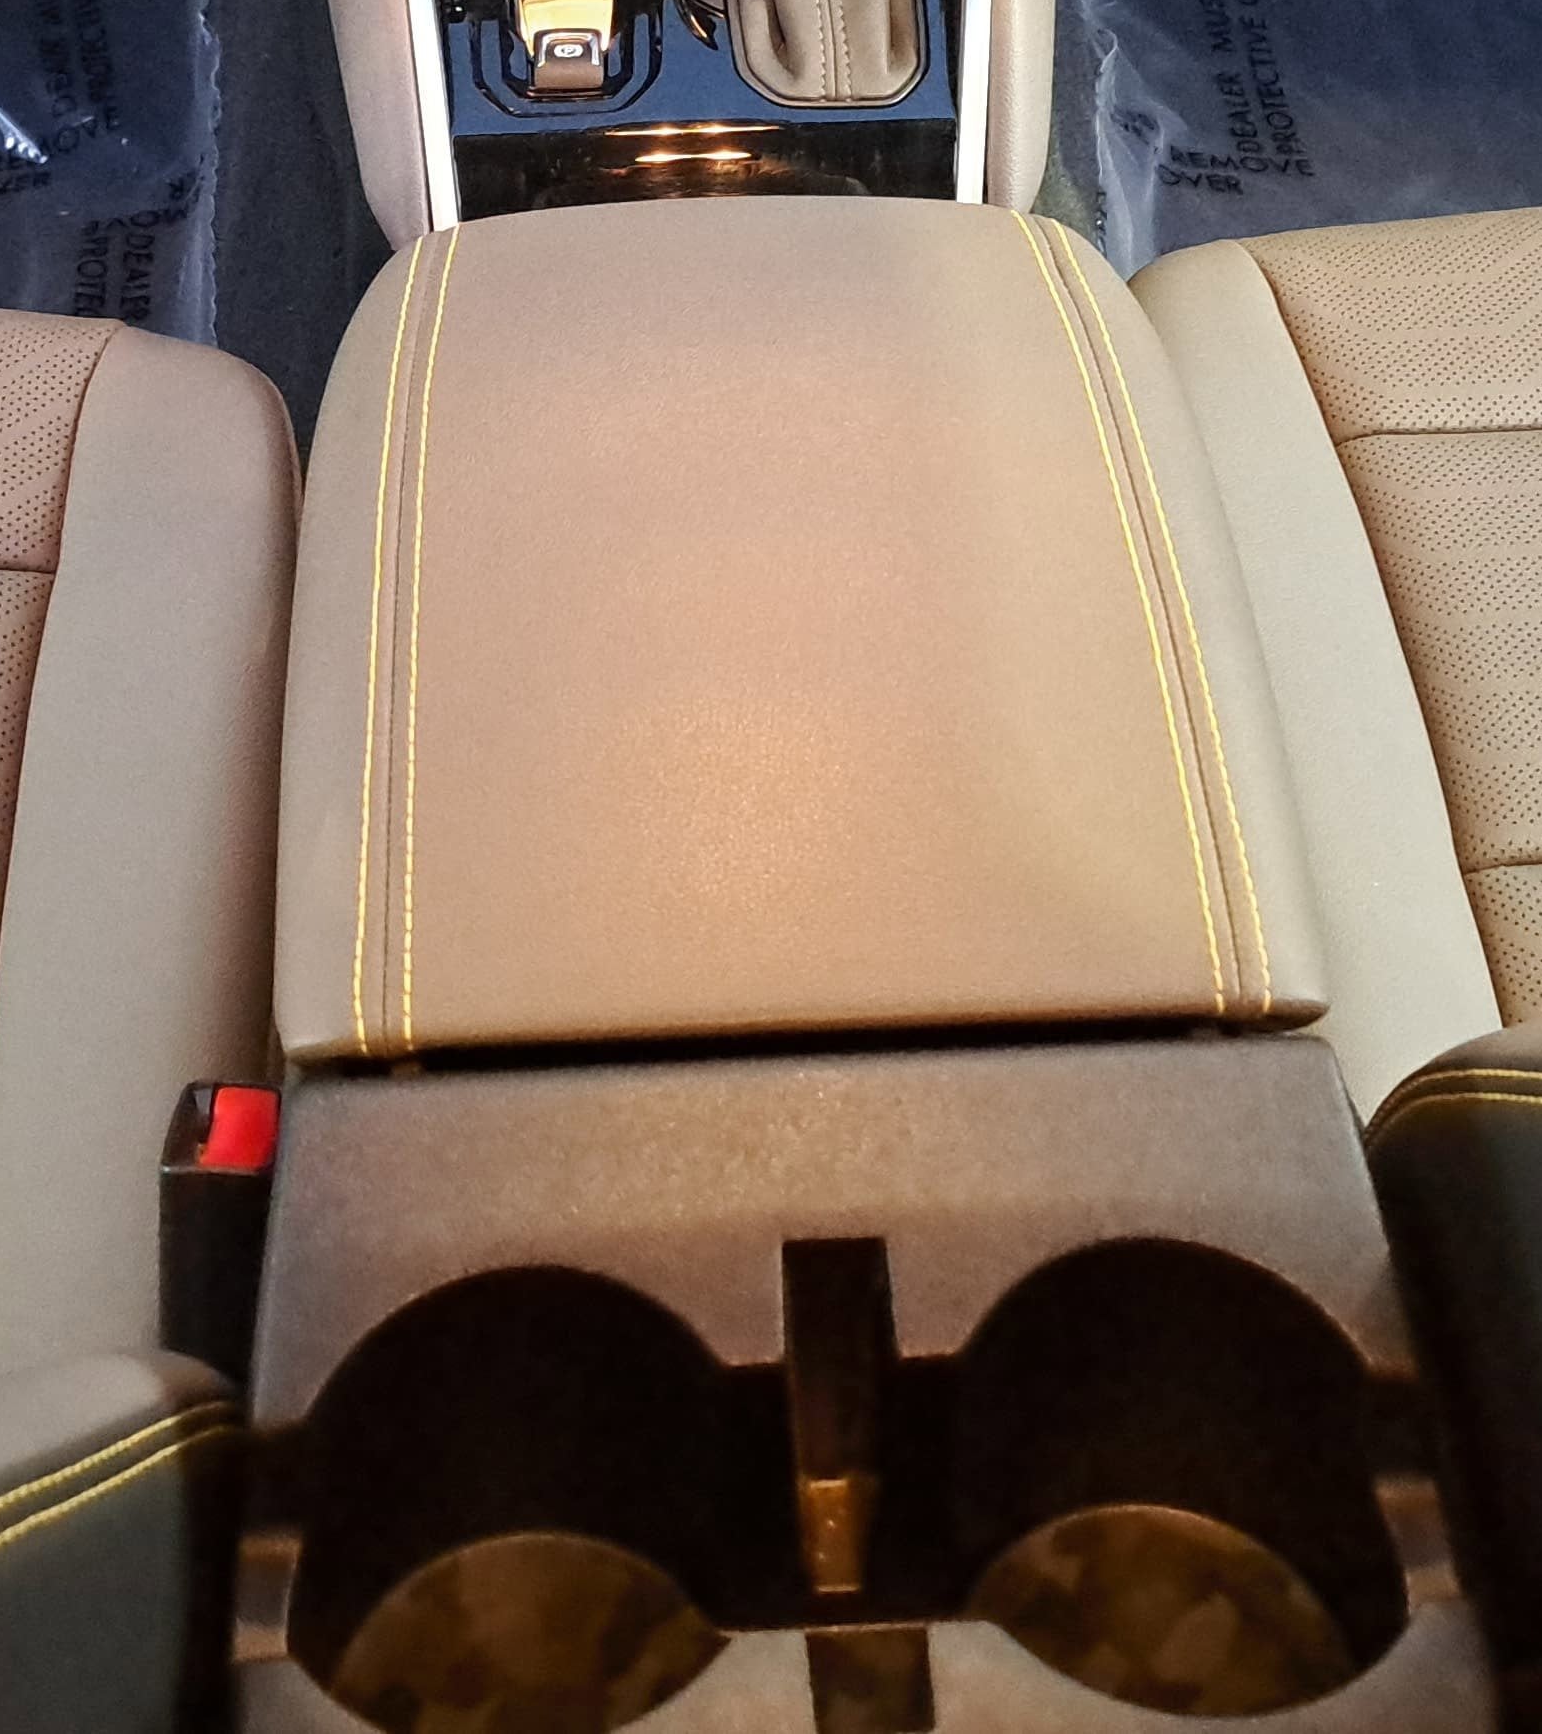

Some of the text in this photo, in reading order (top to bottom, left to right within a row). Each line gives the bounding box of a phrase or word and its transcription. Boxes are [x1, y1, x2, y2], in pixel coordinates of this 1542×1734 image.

[1215, 71, 1262, 156] DEALER
[1241, 14, 1302, 156] PROTECTIVE
[1158, 163, 1244, 194] OVER
[1169, 143, 1316, 179] REMOVE
[118, 233, 156, 322] DEALER
